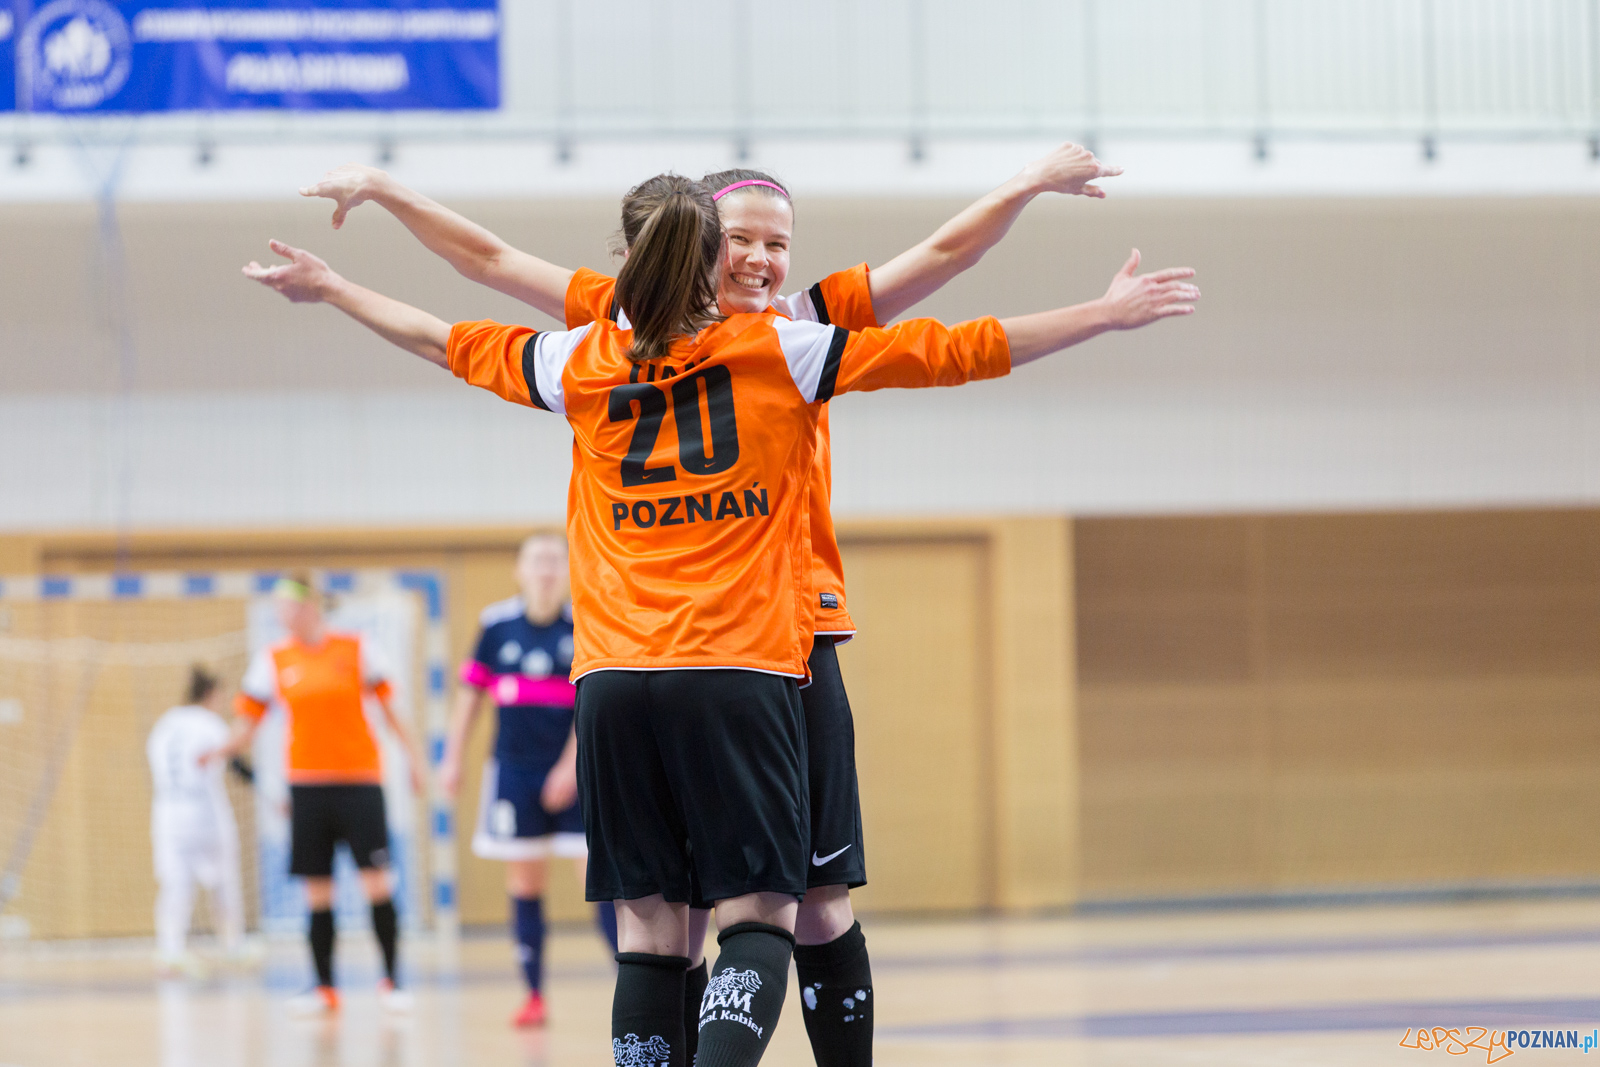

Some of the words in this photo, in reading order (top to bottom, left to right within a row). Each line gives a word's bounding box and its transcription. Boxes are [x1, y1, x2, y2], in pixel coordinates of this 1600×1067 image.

[629, 356, 712, 384] UA
[608, 364, 740, 487] 20
[611, 482, 770, 531] POZNAŃ
[720, 1010, 763, 1039] Kobiet
